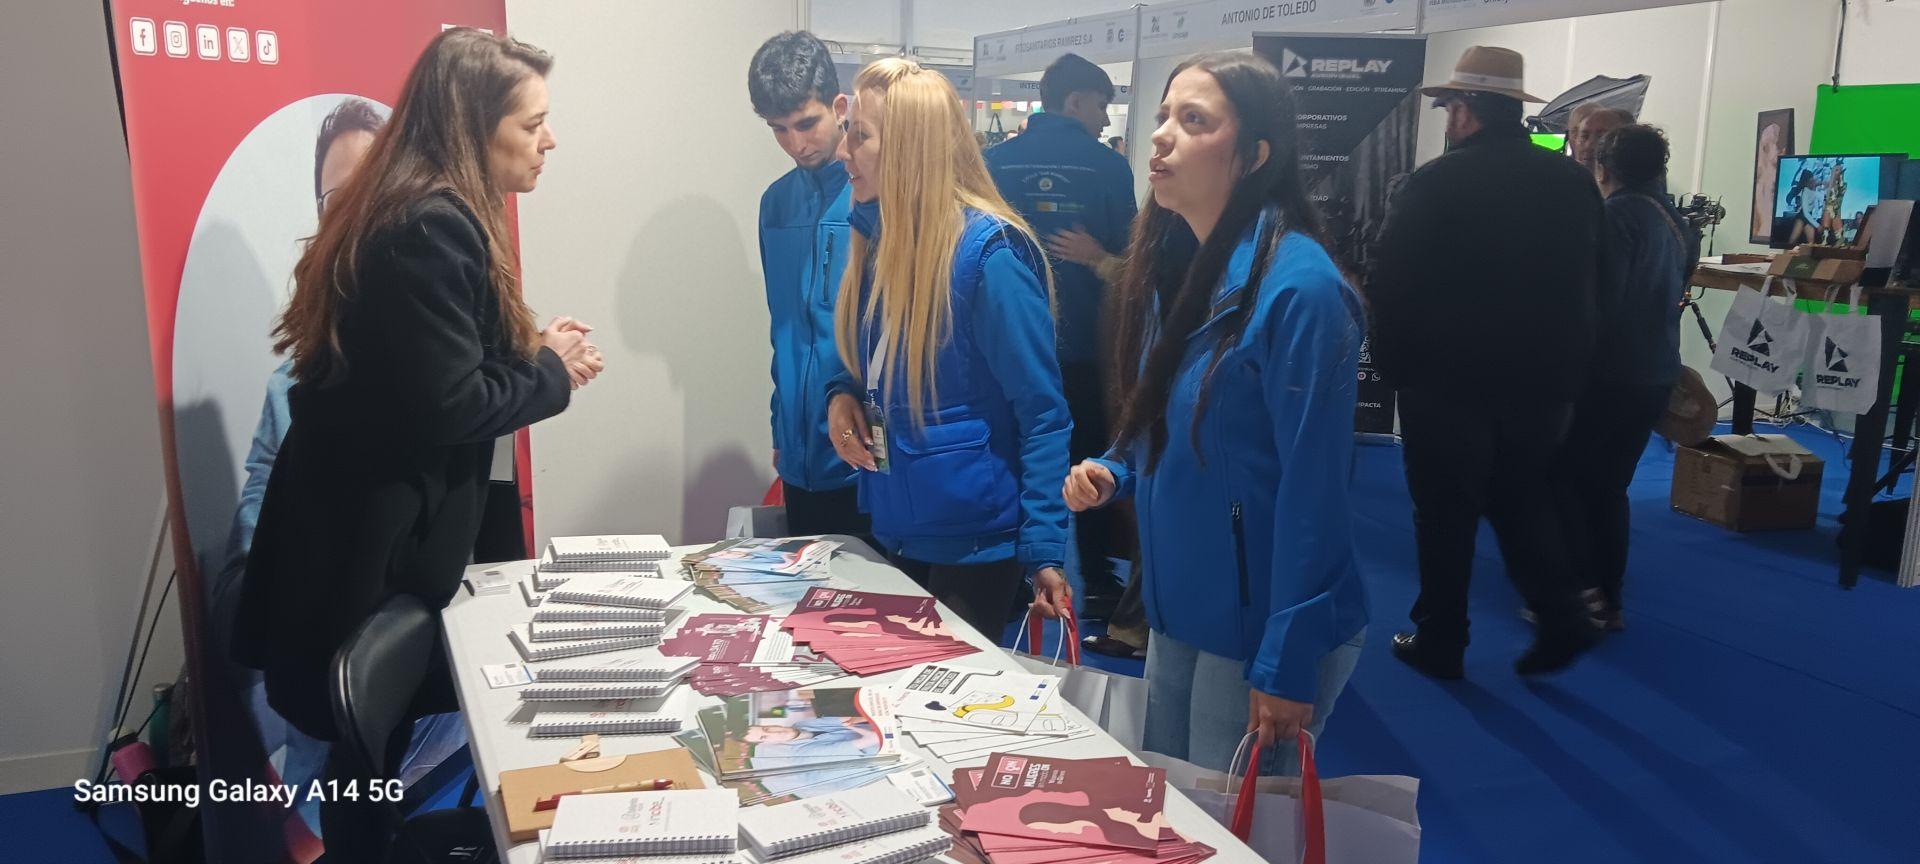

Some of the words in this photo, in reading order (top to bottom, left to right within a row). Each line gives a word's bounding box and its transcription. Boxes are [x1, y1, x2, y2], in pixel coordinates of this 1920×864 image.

[1221, 8, 1260, 25] ANTONIO
[1263, 6, 1275, 19] DE
[1278, 0, 1317, 17] TOLEDO
[1311, 58, 1392, 73] REPLAY
[1731, 346, 1779, 373] REPLAY
[1816, 374, 1861, 388] REPLAY
